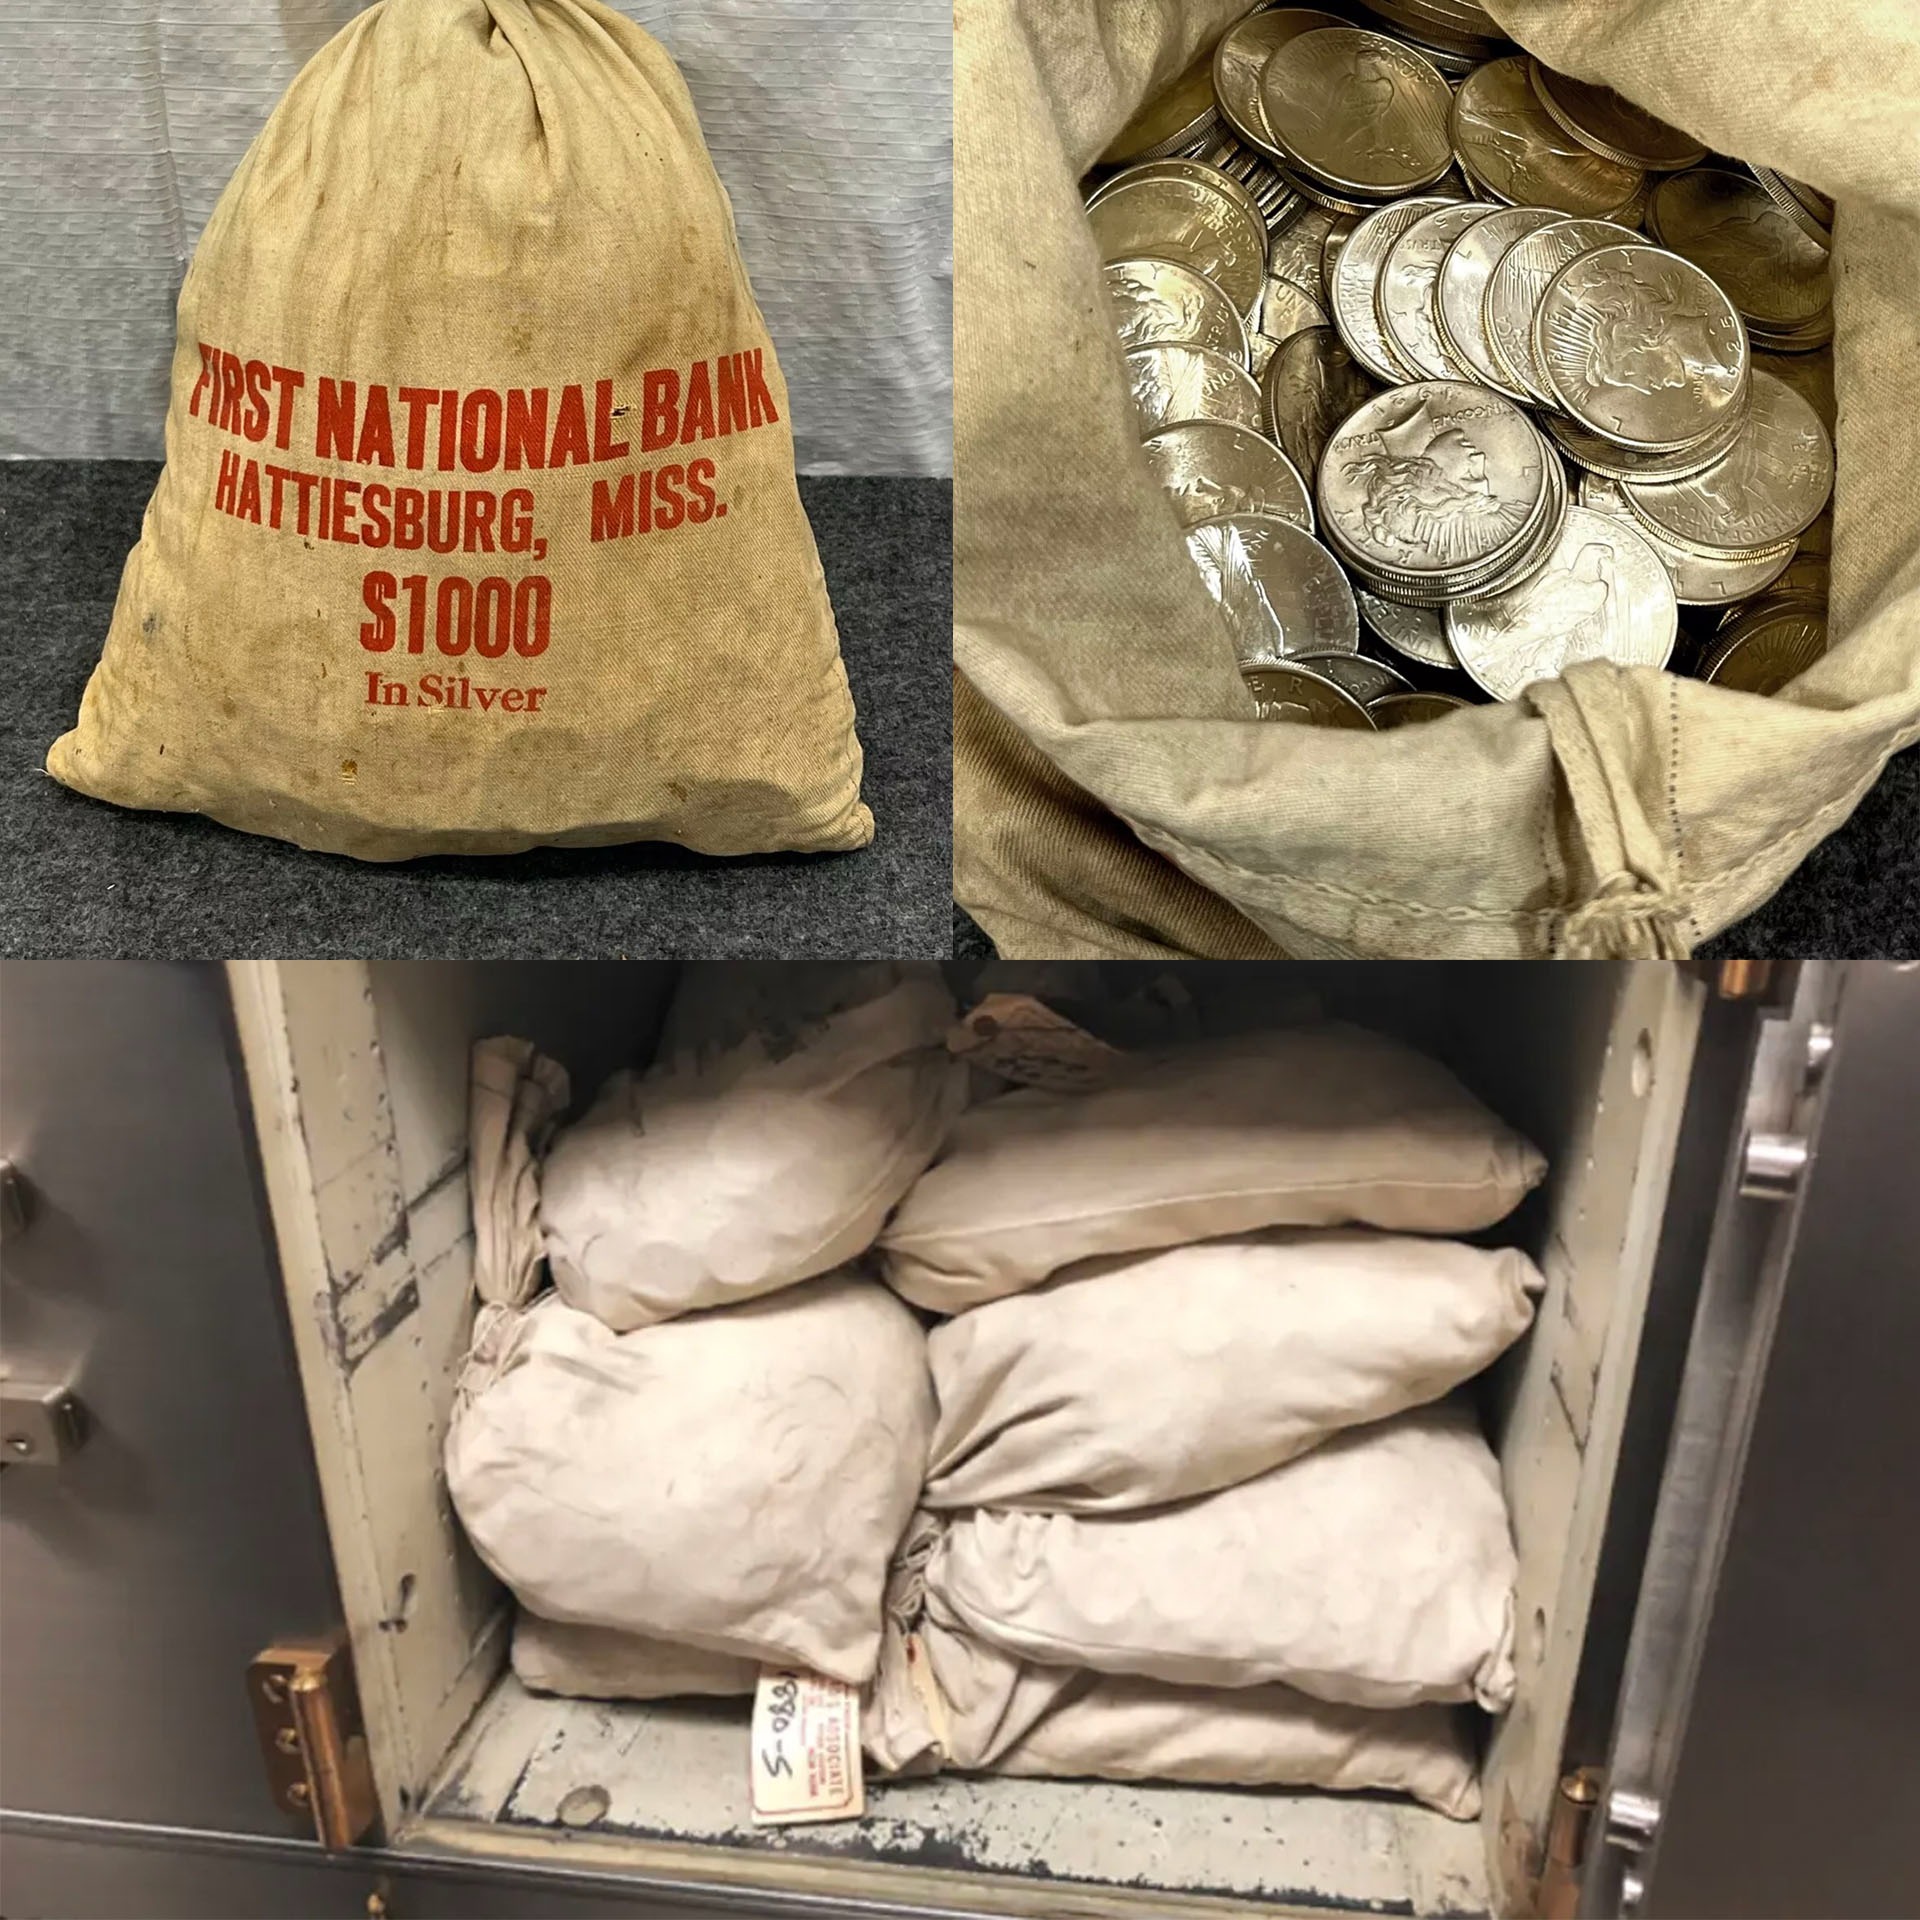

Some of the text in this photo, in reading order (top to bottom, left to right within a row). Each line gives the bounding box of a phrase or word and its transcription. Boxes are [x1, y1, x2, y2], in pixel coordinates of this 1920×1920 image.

[189, 341, 780, 475] FIRST NATIONAL BANK
[214, 448, 728, 561] HATTIESBURG, MISS.
[359, 570, 553, 660] $1000
[365, 671, 548, 713] In Silver
